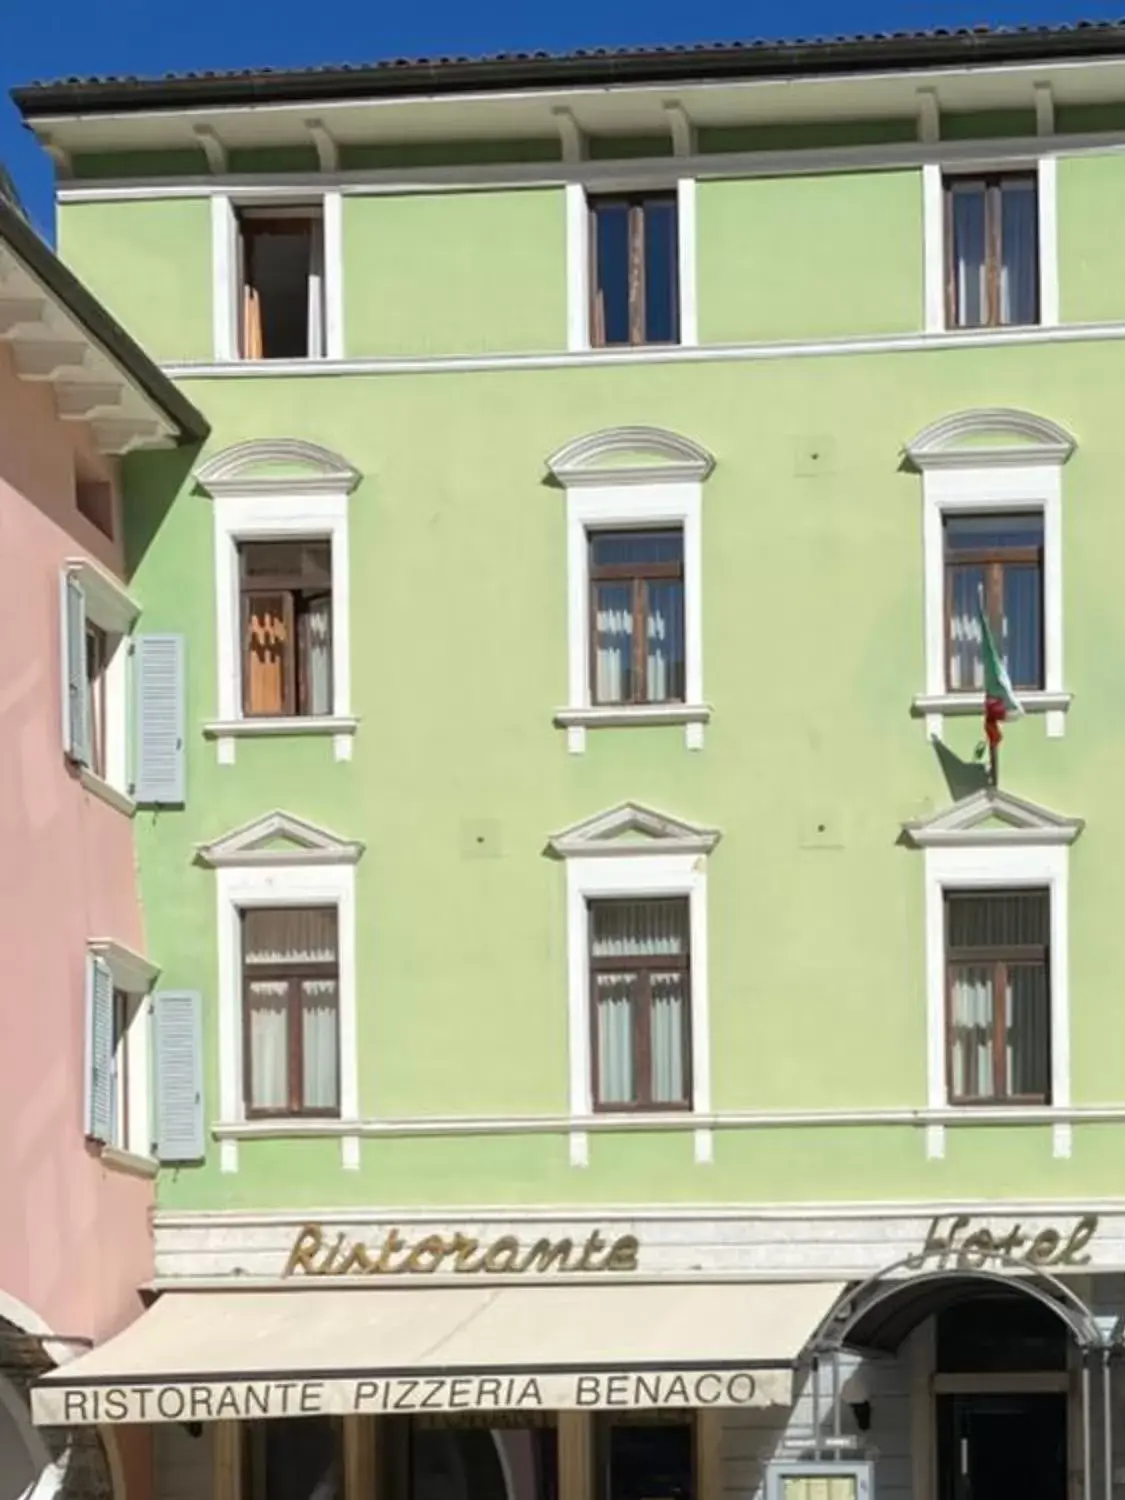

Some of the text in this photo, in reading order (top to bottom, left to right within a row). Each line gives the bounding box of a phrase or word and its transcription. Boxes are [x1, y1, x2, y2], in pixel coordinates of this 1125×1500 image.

[282, 1222, 640, 1278] Ristorante
[905, 1216, 1099, 1271] Hotel
[63, 1373, 757, 1421] RISTORANTE PIZZERIA BENACO
